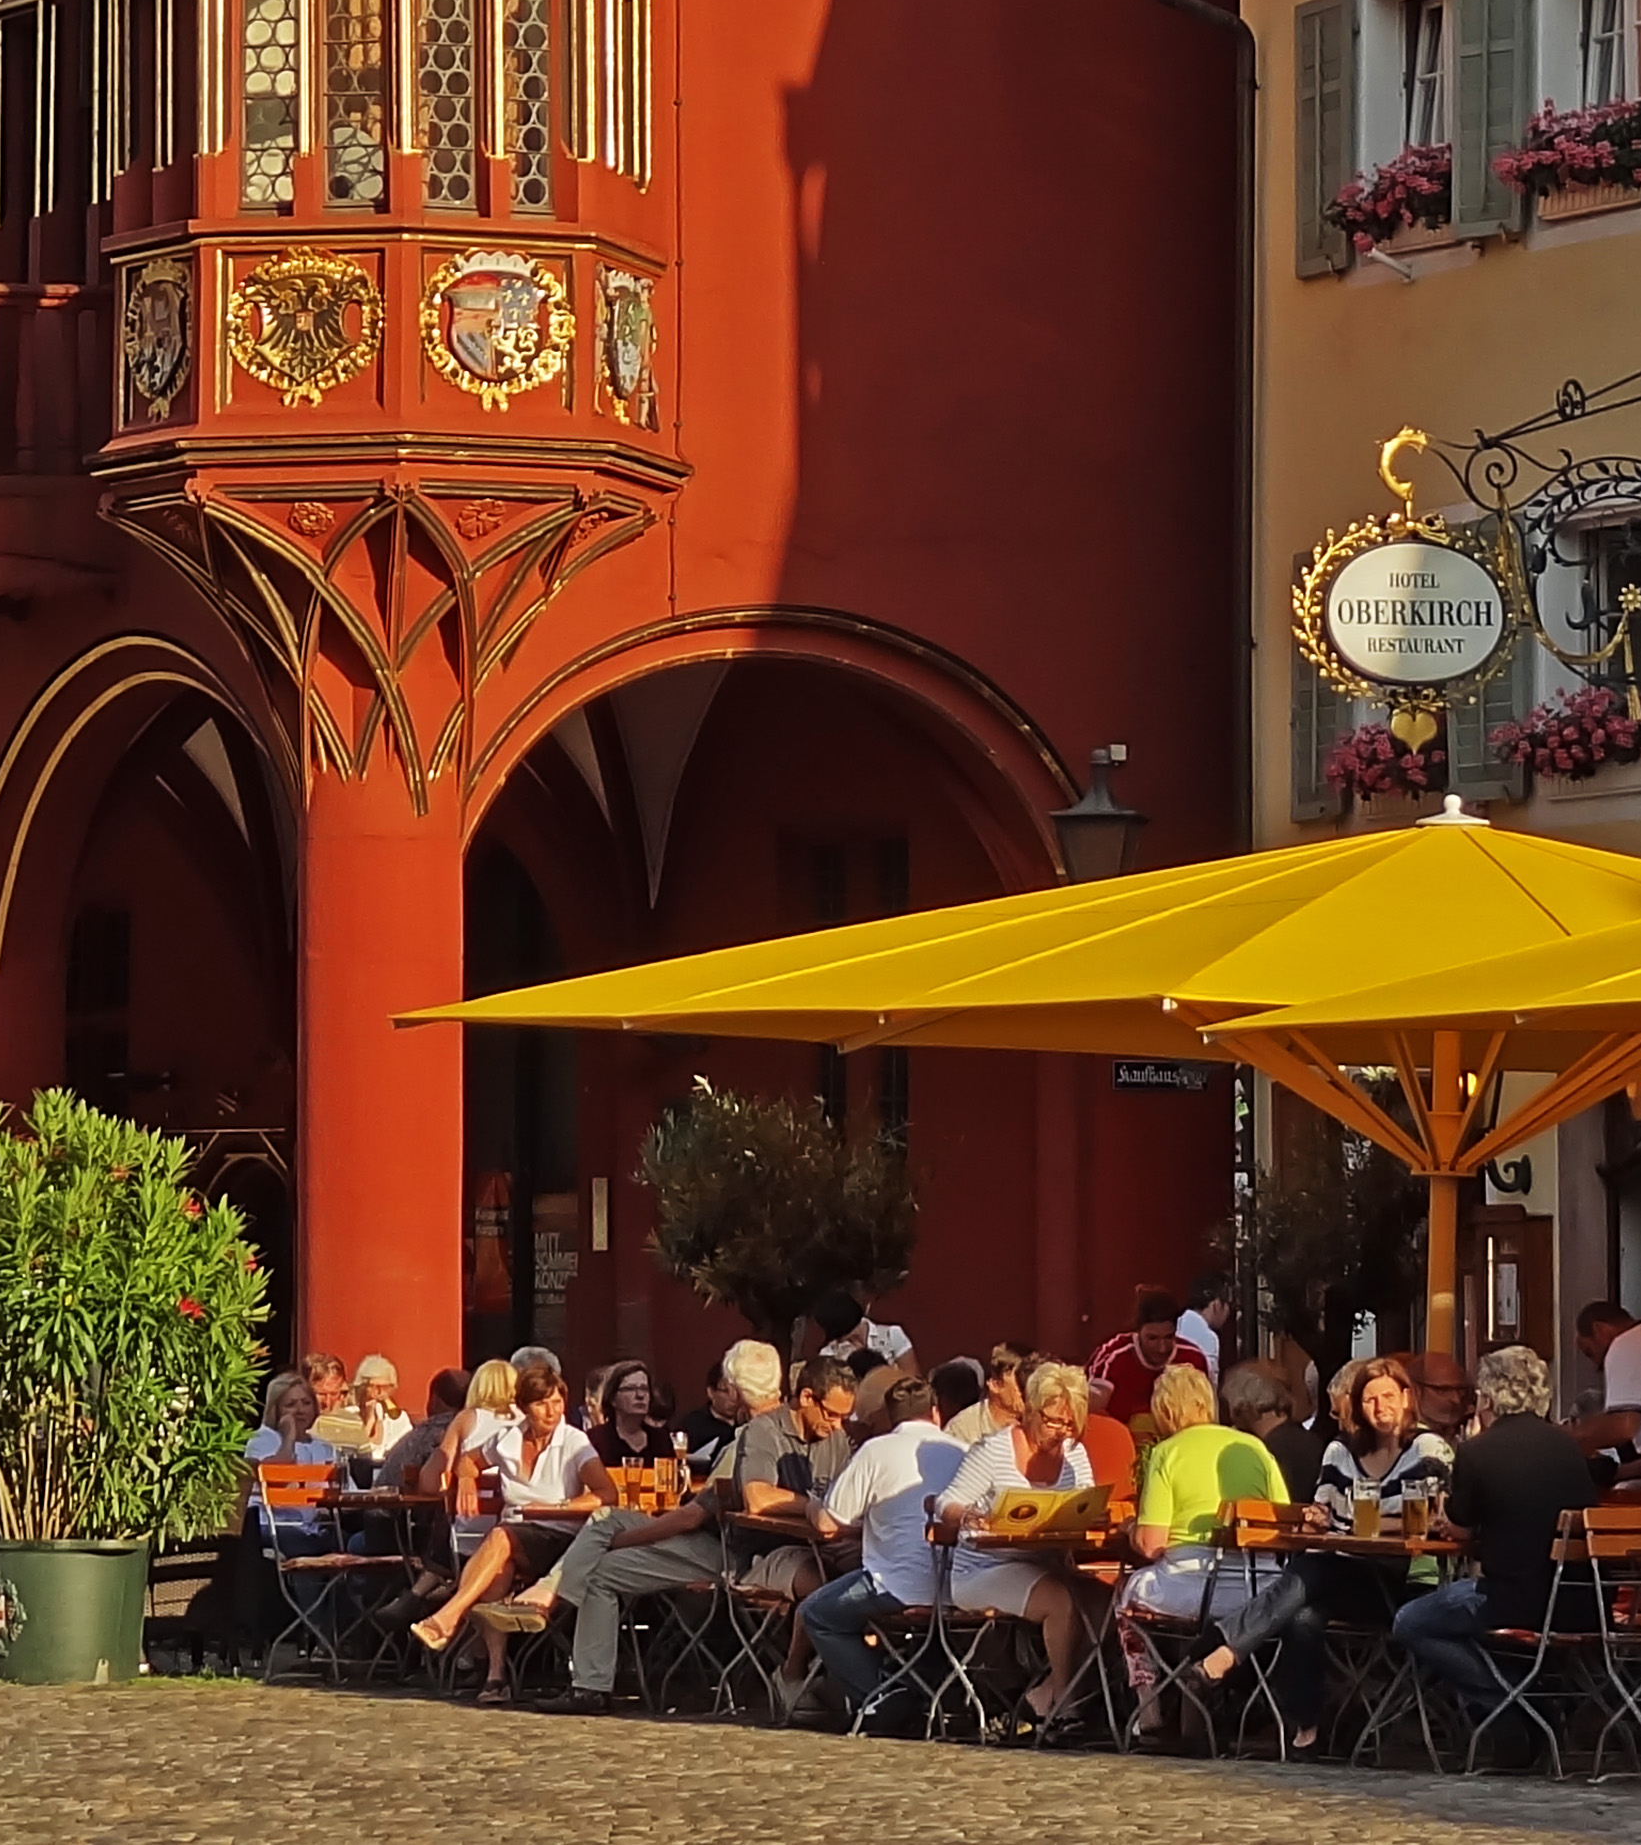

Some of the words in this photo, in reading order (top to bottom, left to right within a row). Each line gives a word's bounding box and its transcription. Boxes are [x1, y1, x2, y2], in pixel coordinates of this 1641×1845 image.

[1388, 572, 1440, 590] HOTEL
[1337, 599, 1495, 628] OBERKIRCH
[1367, 637, 1465, 654] RESTAURANT
